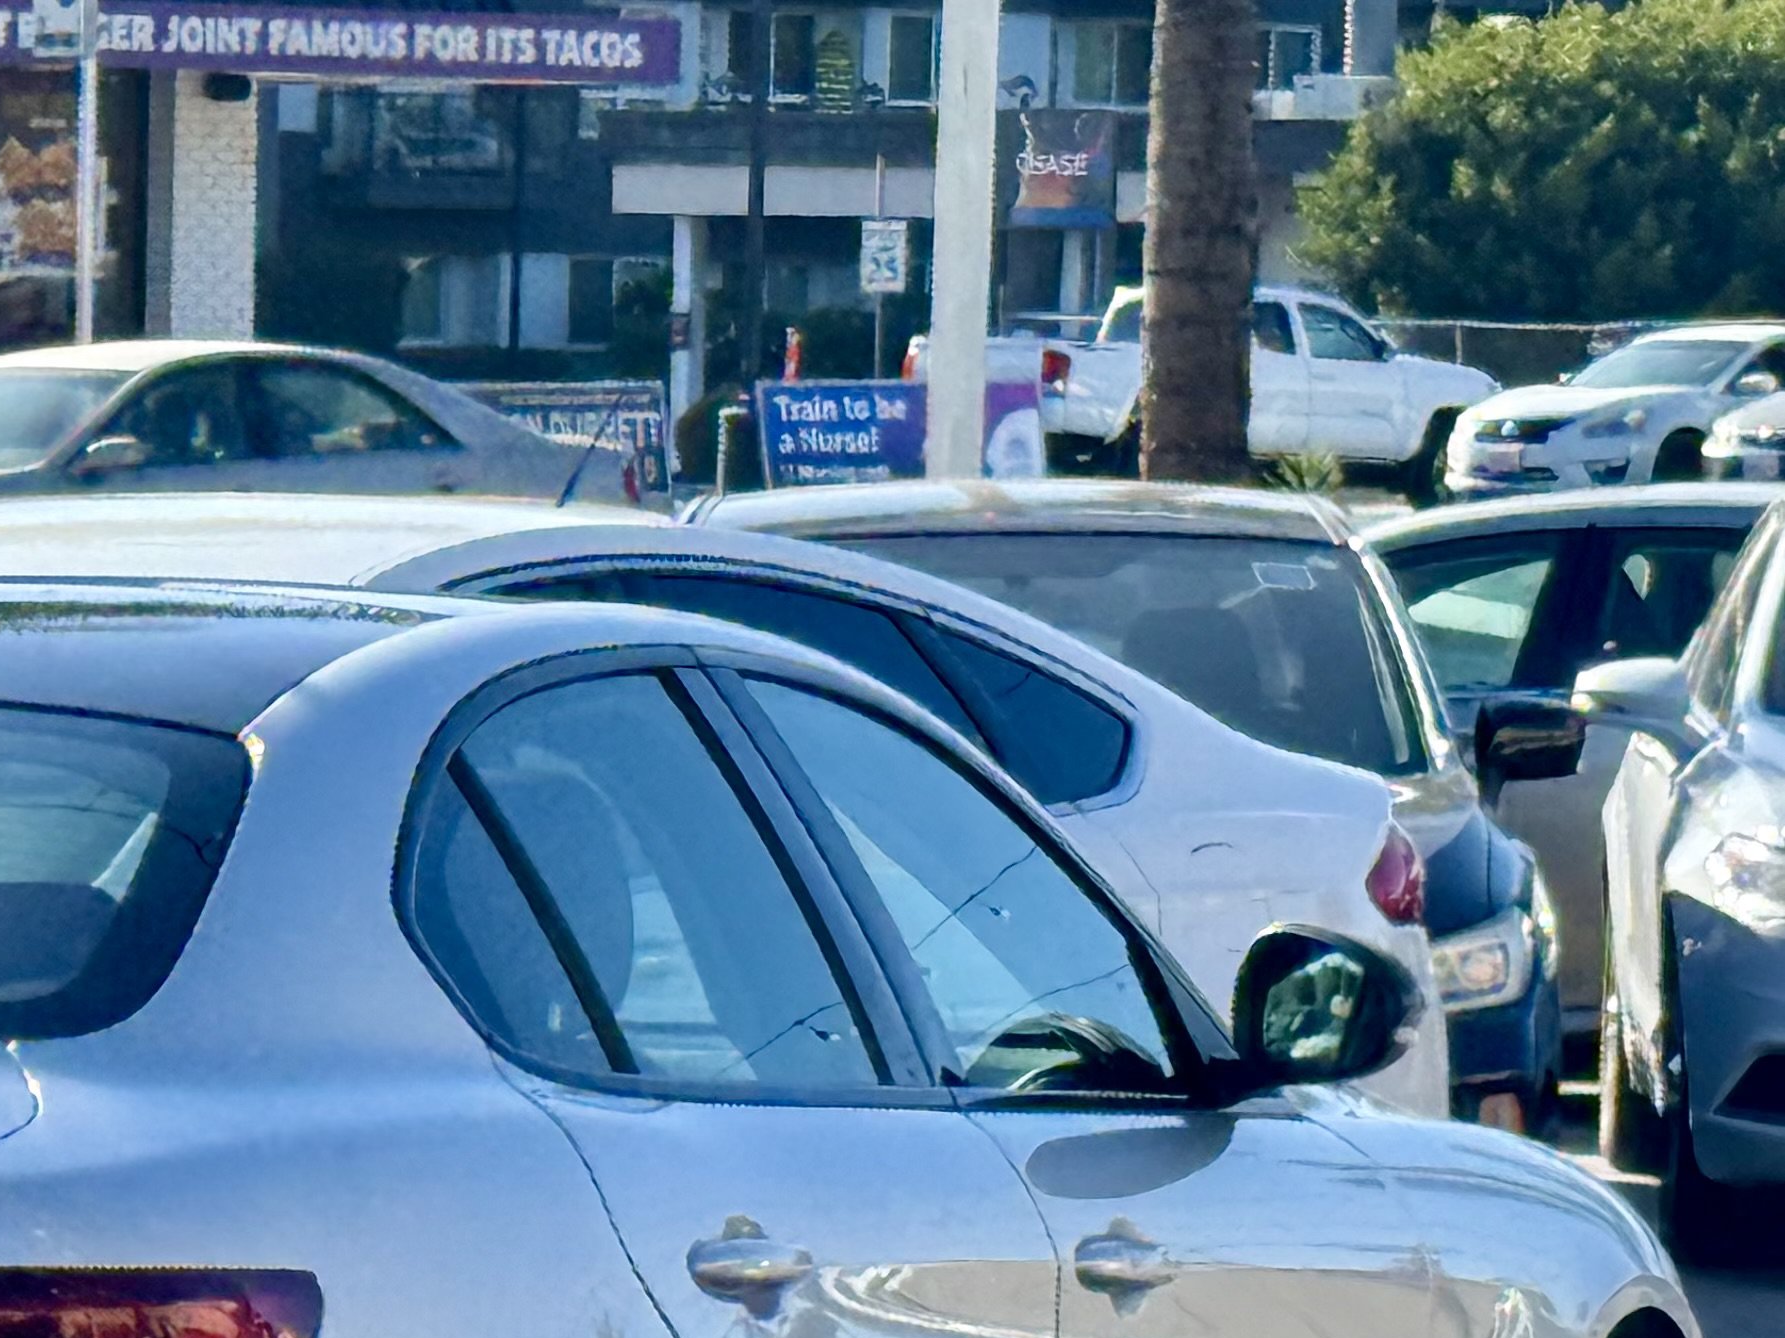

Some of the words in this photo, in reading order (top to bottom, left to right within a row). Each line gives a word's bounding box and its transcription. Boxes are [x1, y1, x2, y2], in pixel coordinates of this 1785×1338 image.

[162, 14, 262, 54] JOINT
[268, 18, 408, 60] FAMOUS
[414, 23, 479, 62] FOR
[486, 27, 537, 64] ITS
[541, 29, 644, 68] TACOS
[773, 394, 838, 423] Train
[843, 395, 871, 421] to
[875, 393, 908, 421] be
